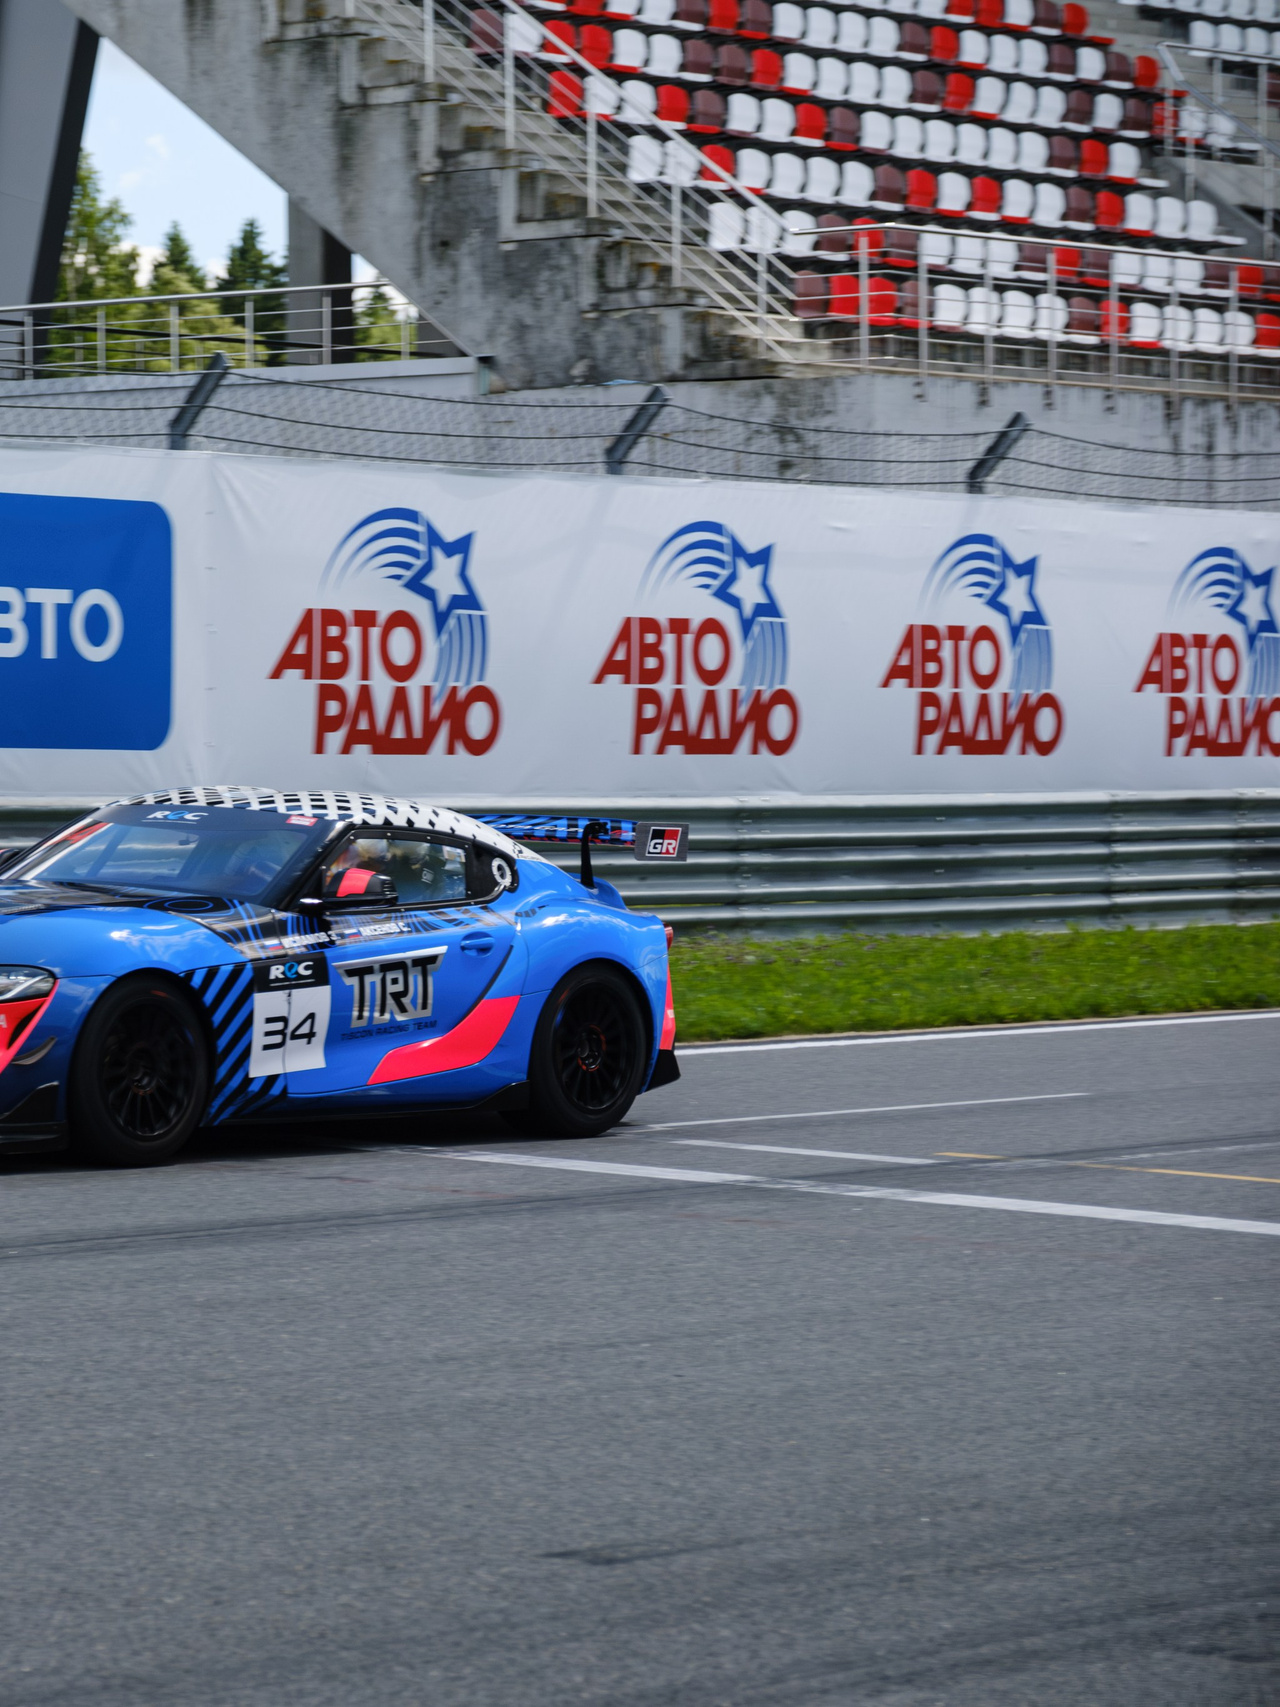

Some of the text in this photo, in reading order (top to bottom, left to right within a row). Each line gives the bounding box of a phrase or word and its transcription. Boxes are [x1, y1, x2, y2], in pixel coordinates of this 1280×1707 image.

[266, 608, 425, 683] АВТО
[589, 616, 732, 686] АВТО
[878, 624, 1003, 690] АВТО
[1131, 632, 1242, 695] АВТО
[310, 683, 504, 757] РАДИО
[630, 688, 801, 757] РАДИО
[913, 691, 1066, 757] РАДИО
[648, 839, 677, 853] GR
[338, 950, 443, 1024] TRT
[262, 1012, 317, 1051] 34
[412, 1020, 438, 1031] TEAM
